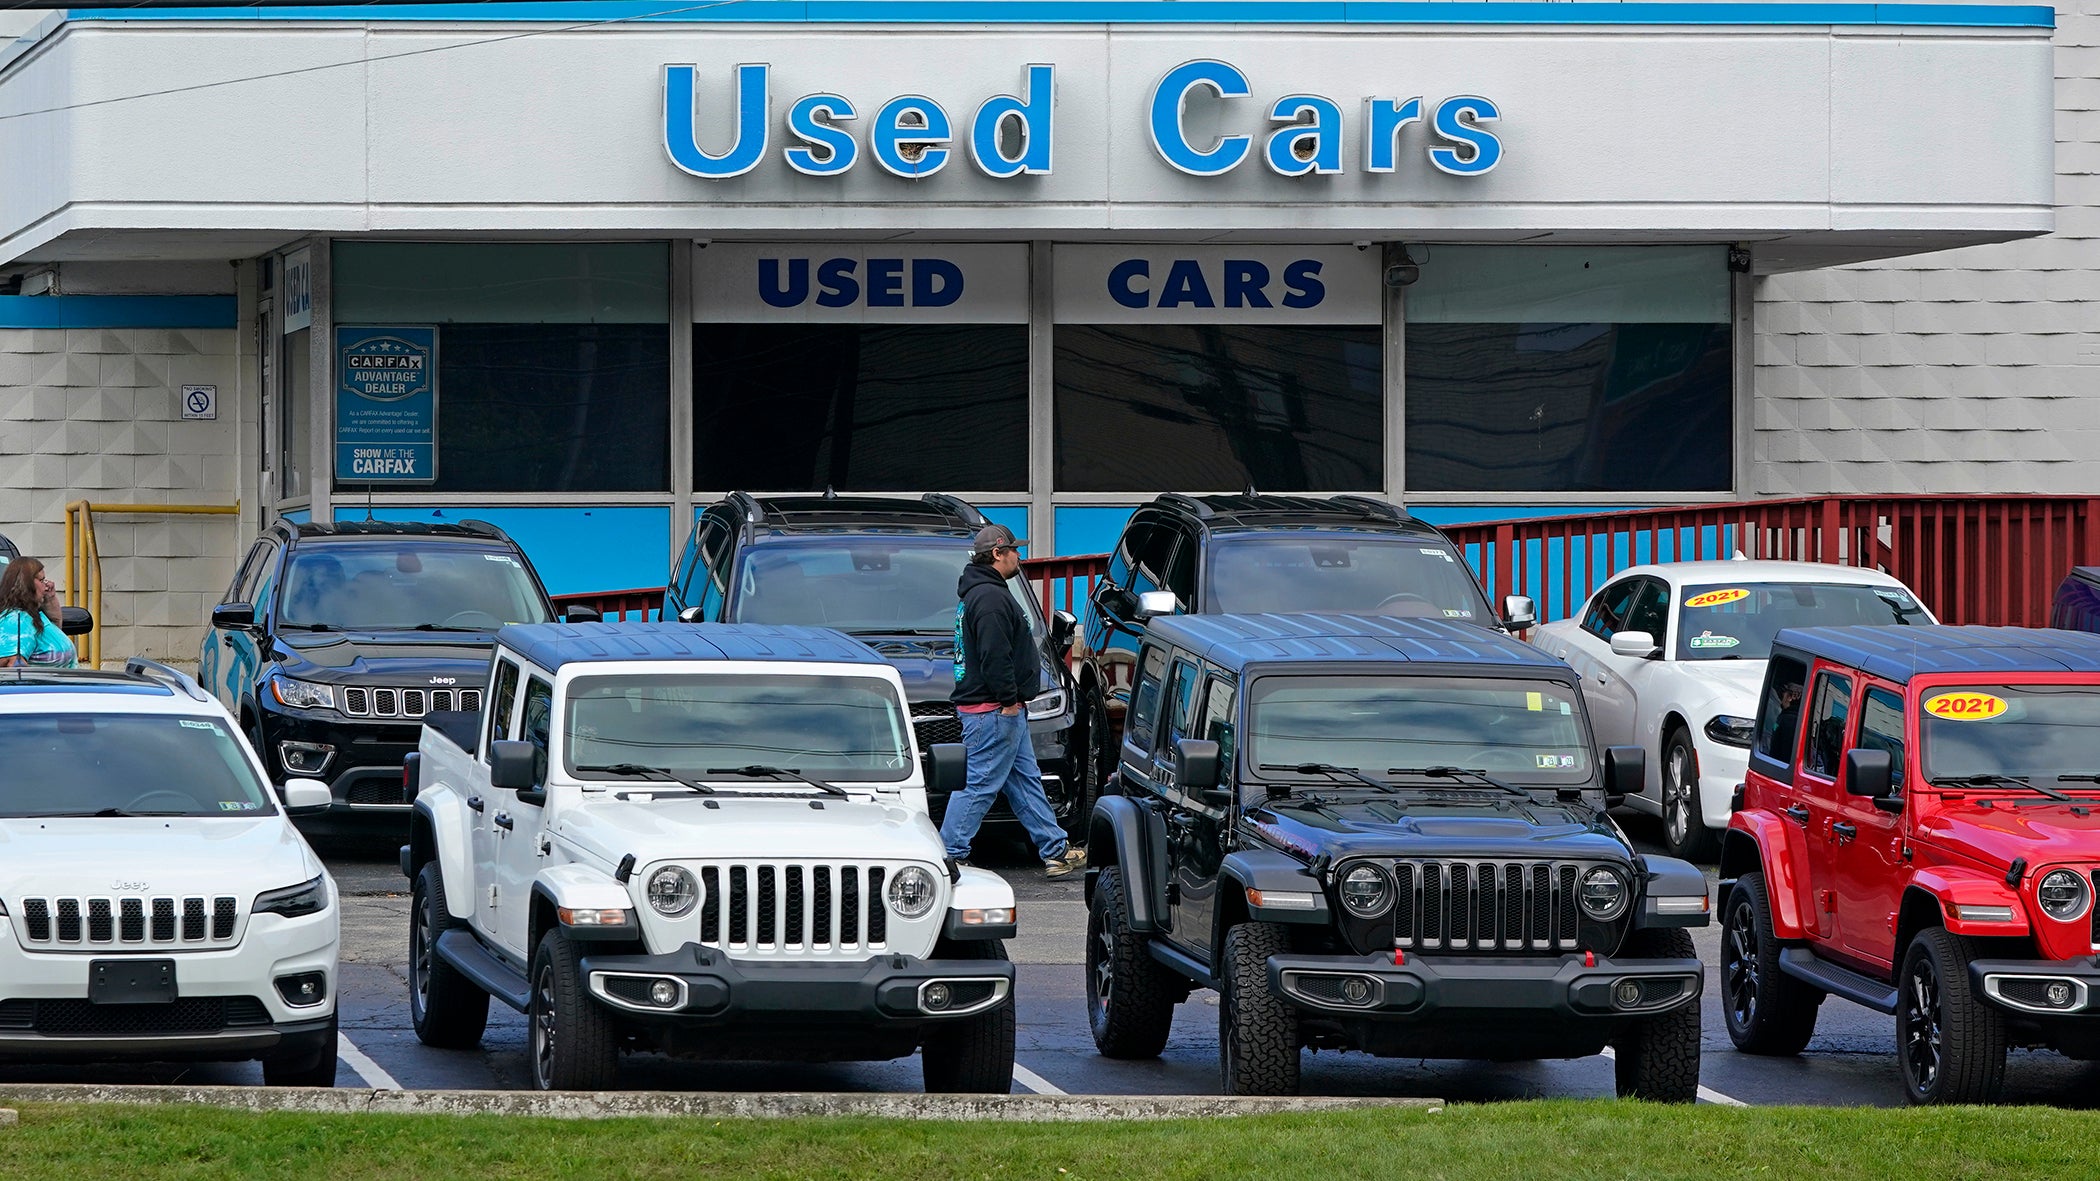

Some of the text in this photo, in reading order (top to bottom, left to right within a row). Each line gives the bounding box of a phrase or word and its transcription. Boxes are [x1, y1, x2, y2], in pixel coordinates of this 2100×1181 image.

[661, 58, 1504, 179] Used Cars
[286, 265, 300, 317] USED
[758, 258, 965, 309] USED
[1107, 259, 1326, 309] CARS
[350, 356, 420, 369] CARFAX
[354, 371, 417, 382] ADVANTAGE
[365, 383, 406, 394] DEALER
[353, 448, 415, 458] SHOW ME THE
[352, 458, 415, 474] CARFAX
[1694, 590, 1740, 606] 2021
[429, 676, 456, 686] Jeep
[1935, 698, 1996, 713] 2021
[111, 879, 150, 892] Jeep
